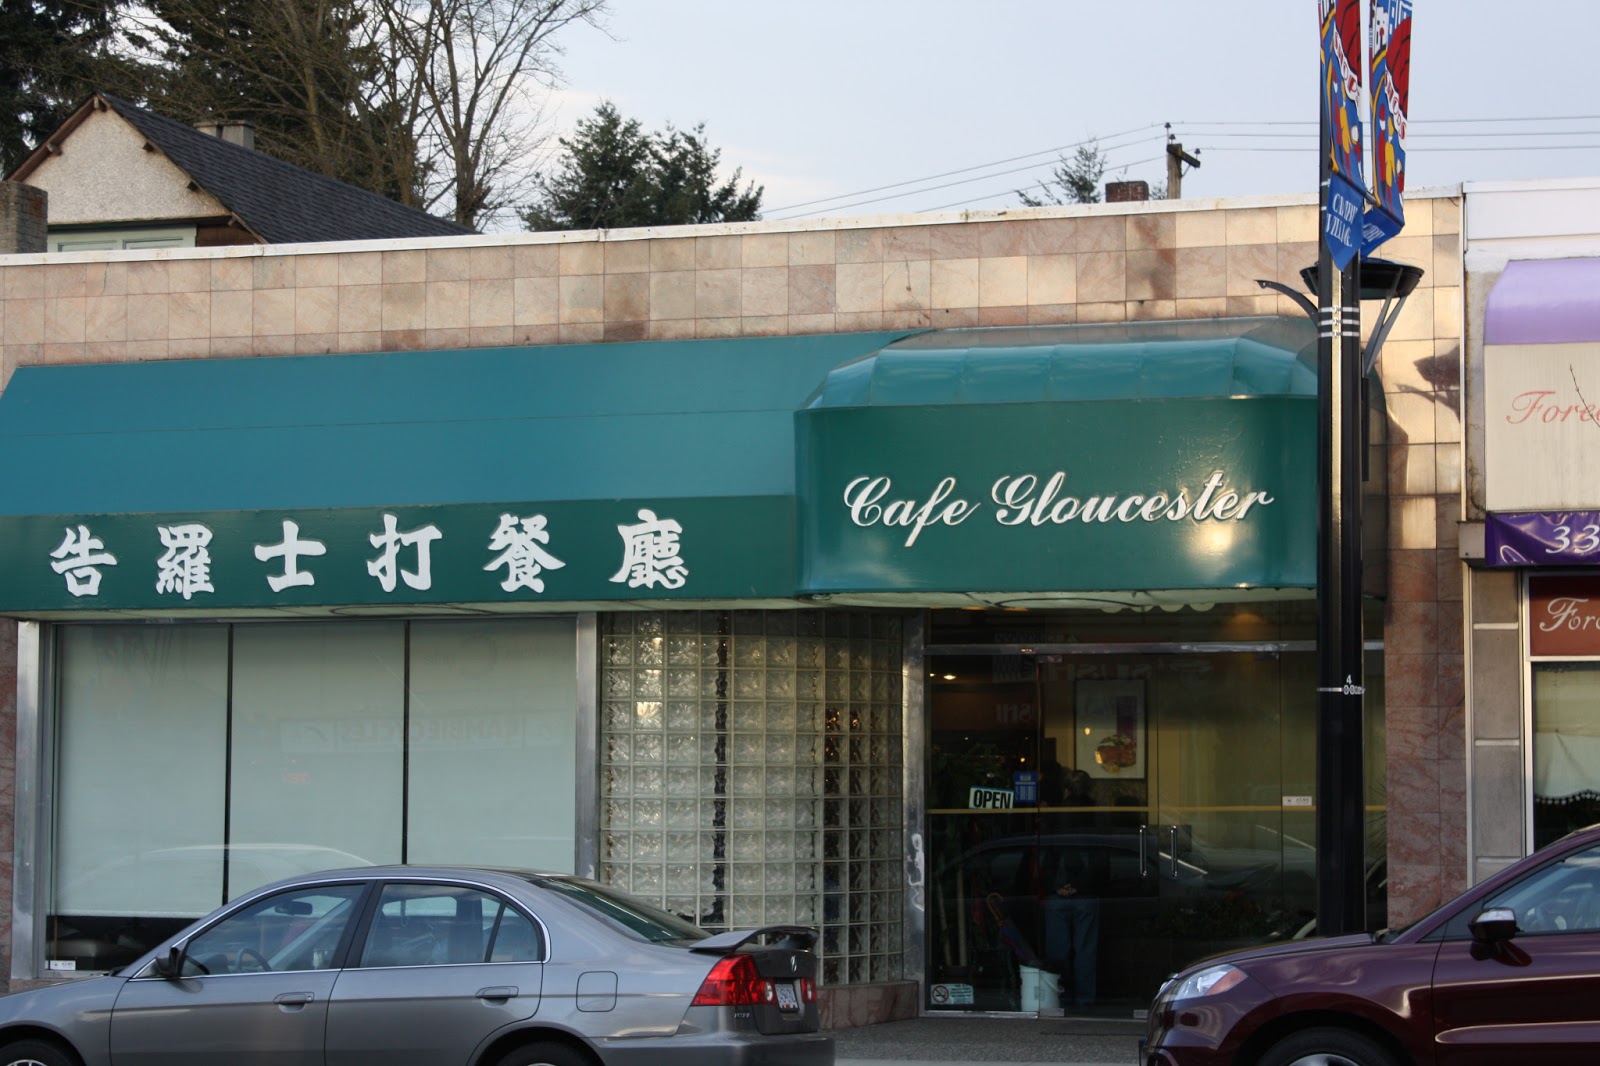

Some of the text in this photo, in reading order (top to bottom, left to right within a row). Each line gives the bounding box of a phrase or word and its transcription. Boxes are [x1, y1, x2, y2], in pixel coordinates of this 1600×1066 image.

[842, 470, 1275, 548] Cafe Gloucester
[49, 508, 689, 600] 告羅士打餐廳
[973, 789, 1011, 809] OPEN
